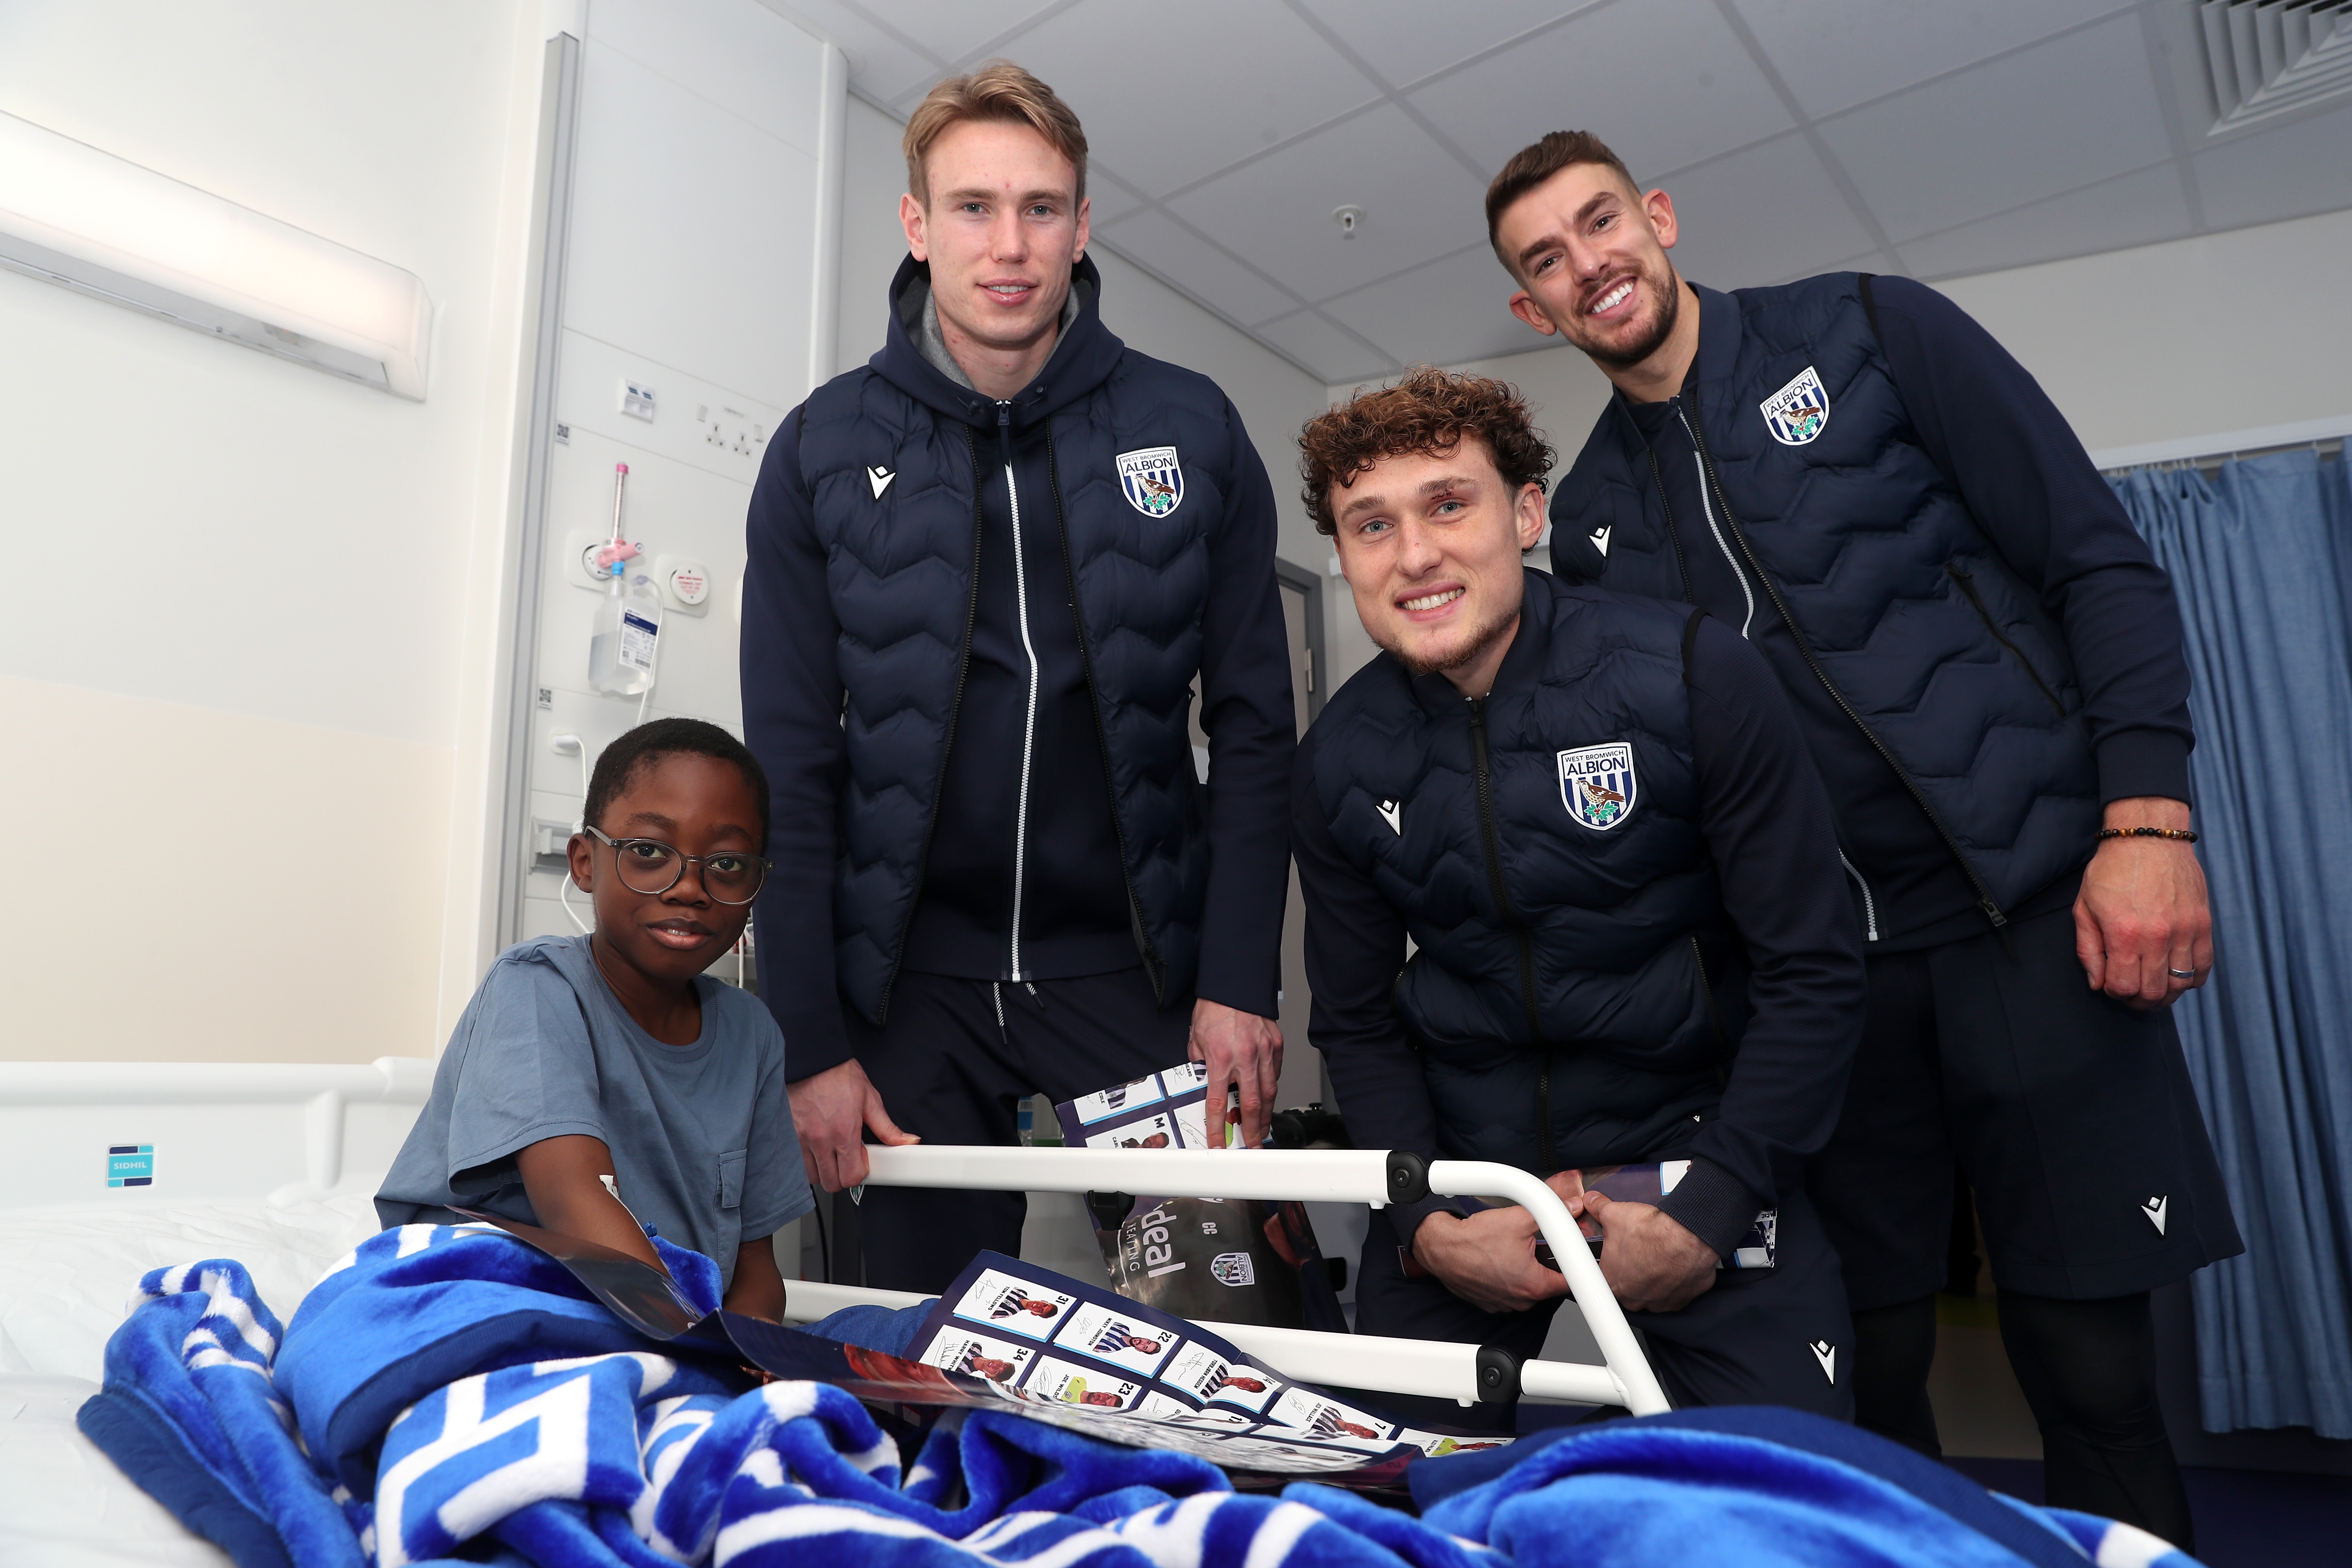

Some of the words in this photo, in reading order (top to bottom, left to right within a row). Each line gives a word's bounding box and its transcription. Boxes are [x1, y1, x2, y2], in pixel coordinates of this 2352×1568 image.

[1766, 395, 1781, 407] WEST
[1782, 374, 1809, 395] BROMWICH
[1770, 378, 1813, 416] ALBION
[1140, 452, 1171, 460] BROMWICH
[1126, 457, 1173, 473] ALBION
[1586, 750, 1624, 760] BROMWICH
[1567, 756, 1626, 776] ALBION
[1154, 1117, 1165, 1128] M
[1202, 1222, 1218, 1235] CC
[1237, 1256, 1247, 1281] ALBION
[988, 1293, 1003, 1311] FELLOWS
[1055, 1295, 1069, 1305] 31
[1103, 1317, 1112, 1329] MIKEY
[1087, 1329, 1103, 1346] JOHNSTON
[1157, 1332, 1172, 1342] 22
[958, 1340, 970, 1355] HARRY
[1013, 1348, 1028, 1361] 34
[1262, 1376, 1276, 1385] 14
[1118, 1383, 1134, 1395] 23
[1305, 1408, 1318, 1422] WALLACE
